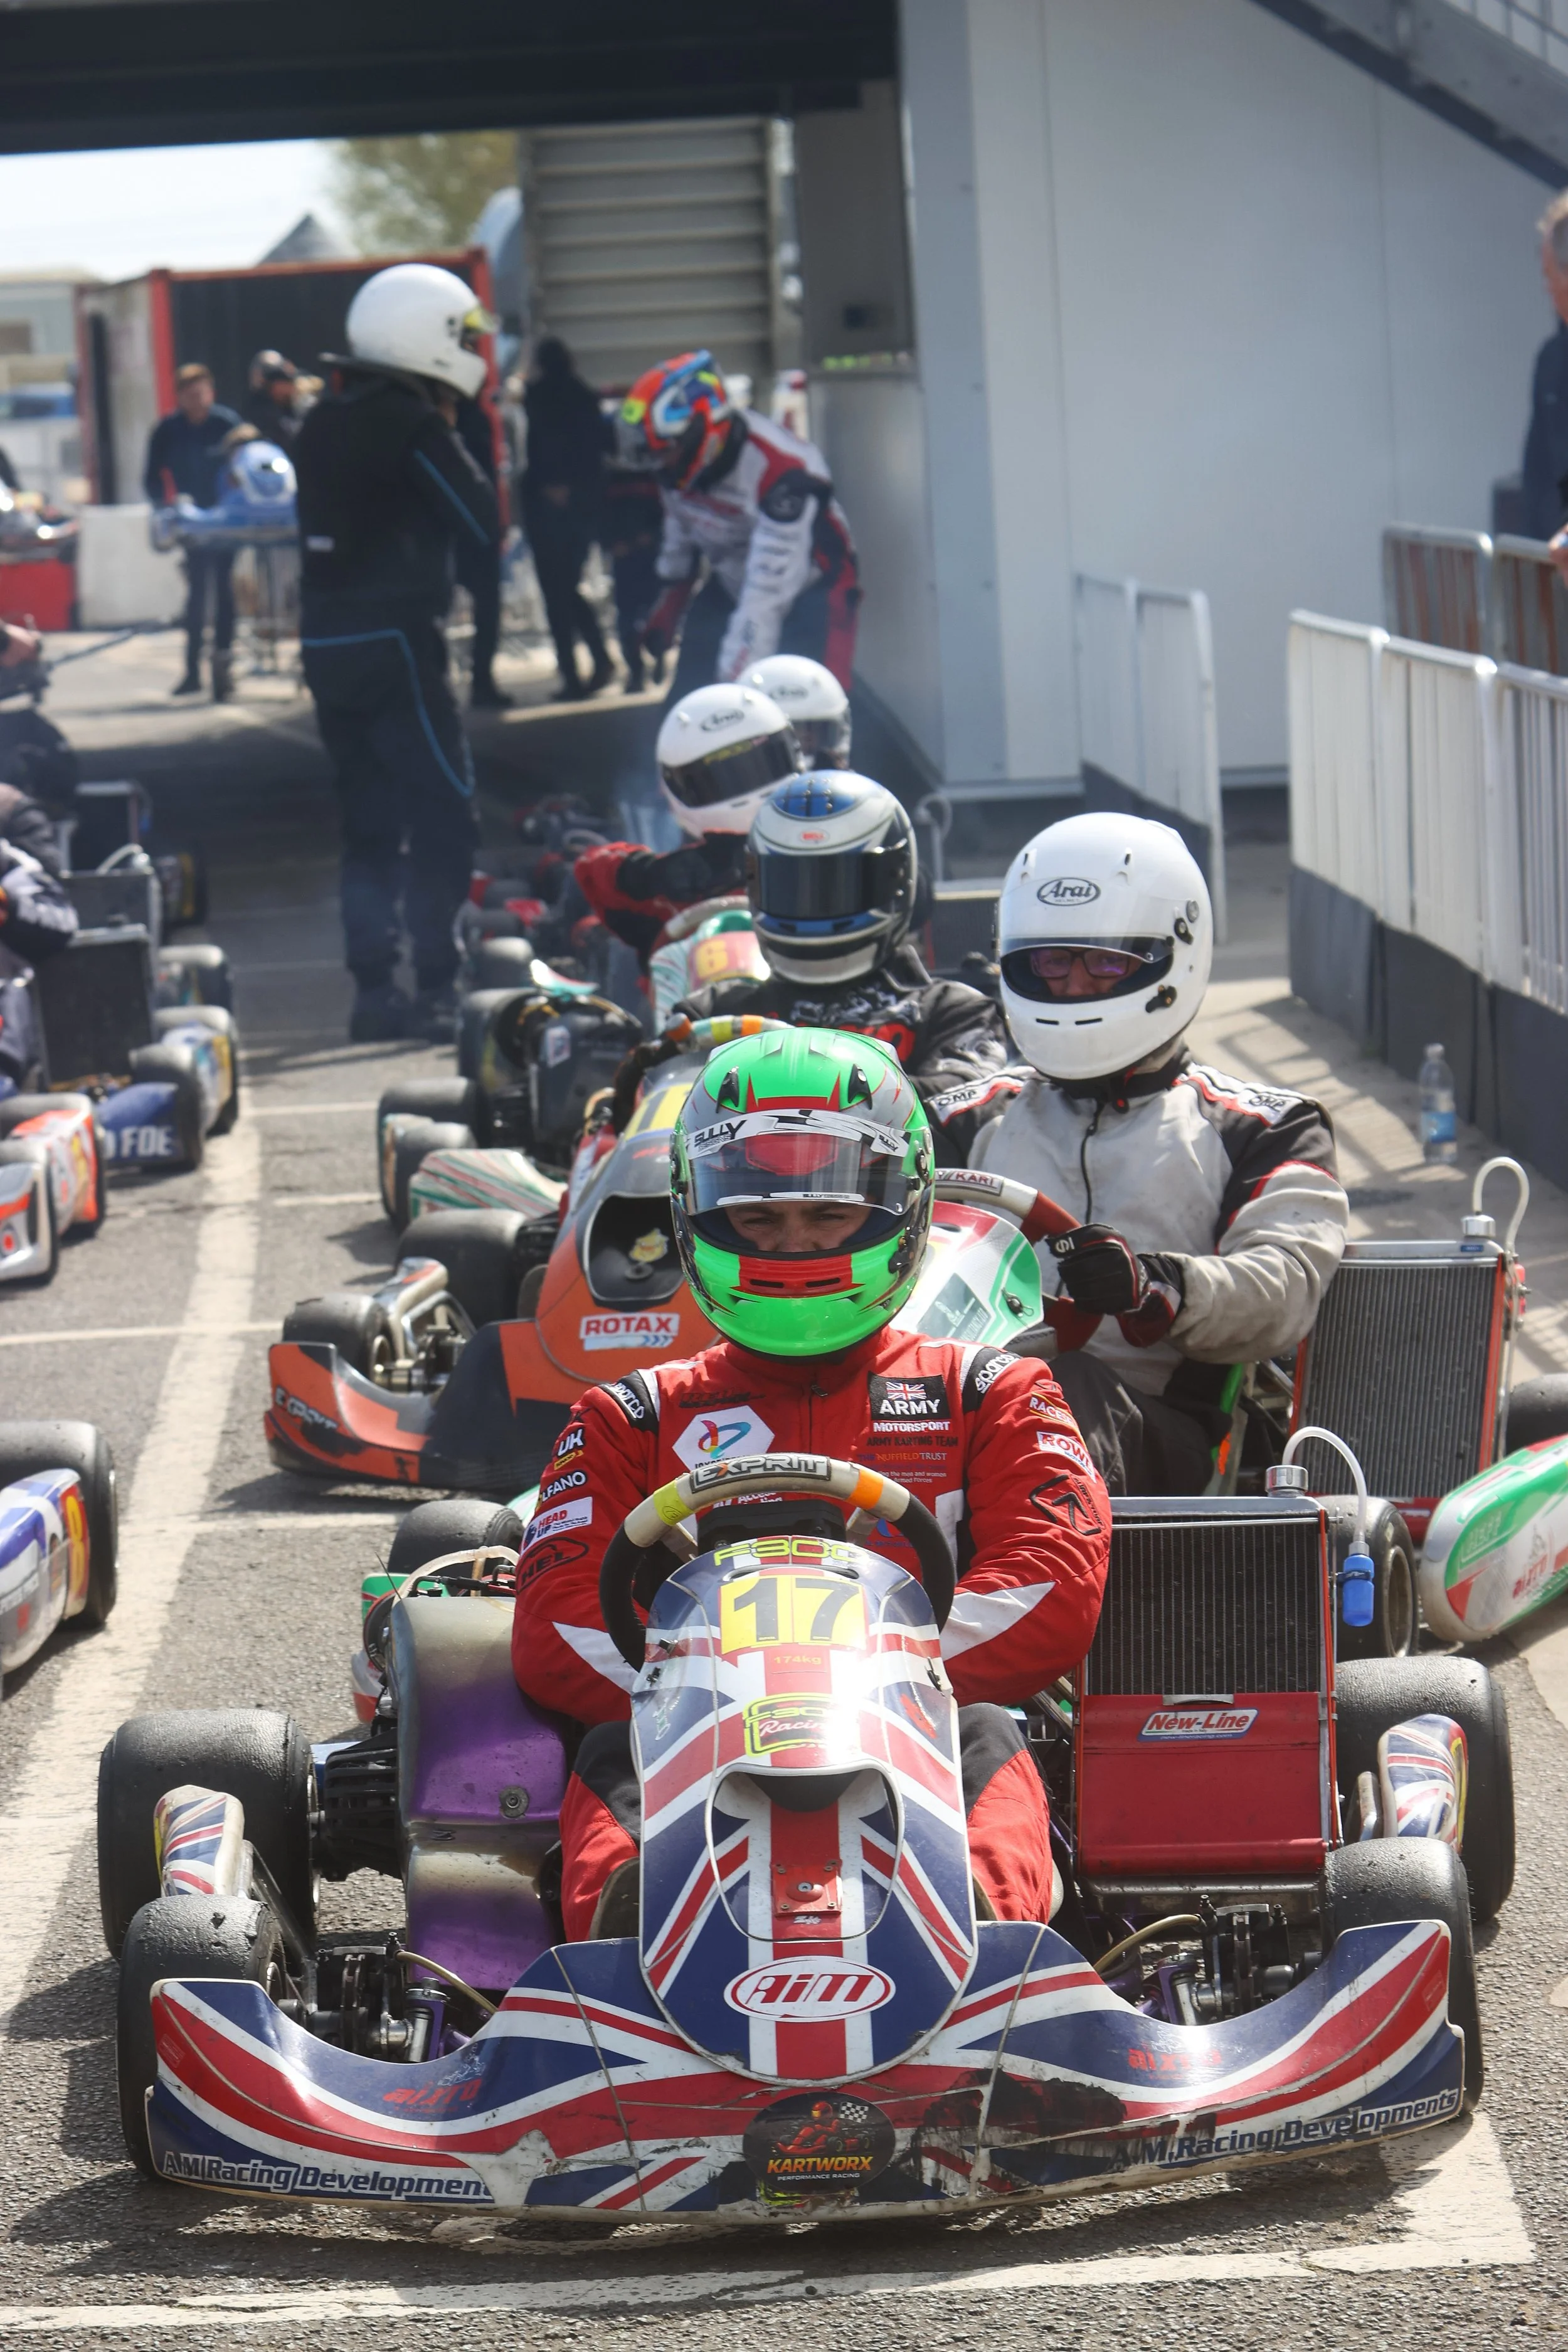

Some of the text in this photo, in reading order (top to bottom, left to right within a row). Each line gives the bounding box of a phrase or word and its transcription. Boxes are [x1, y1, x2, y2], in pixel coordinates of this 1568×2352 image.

[1049, 881, 1093, 898] Arai
[694, 1120, 748, 1148] SULLY
[585, 1317, 672, 1336] ROTAX
[975, 1353, 1015, 1392] sparco
[879, 1399, 941, 1416] ARMY
[873, 1421, 950, 1433] MOTORSPORT
[558, 1429, 584, 1456] UK
[866, 1436, 959, 1446] ARMY KARTING TEAM
[876, 1453, 919, 1461] NUFFIELD
[919, 1452, 947, 1461] TRUST
[696, 1454, 827, 1483] EXPRIT
[538, 1510, 568, 1527] HEAD
[537, 1524, 552, 1538] UP
[733, 1577, 860, 1642] 17
[773, 1656, 822, 1665] 174kg
[758, 1720, 828, 1737] Racin
[1147, 1712, 1250, 1731] New-Line
[767, 2156, 873, 2174] KARTWORX
